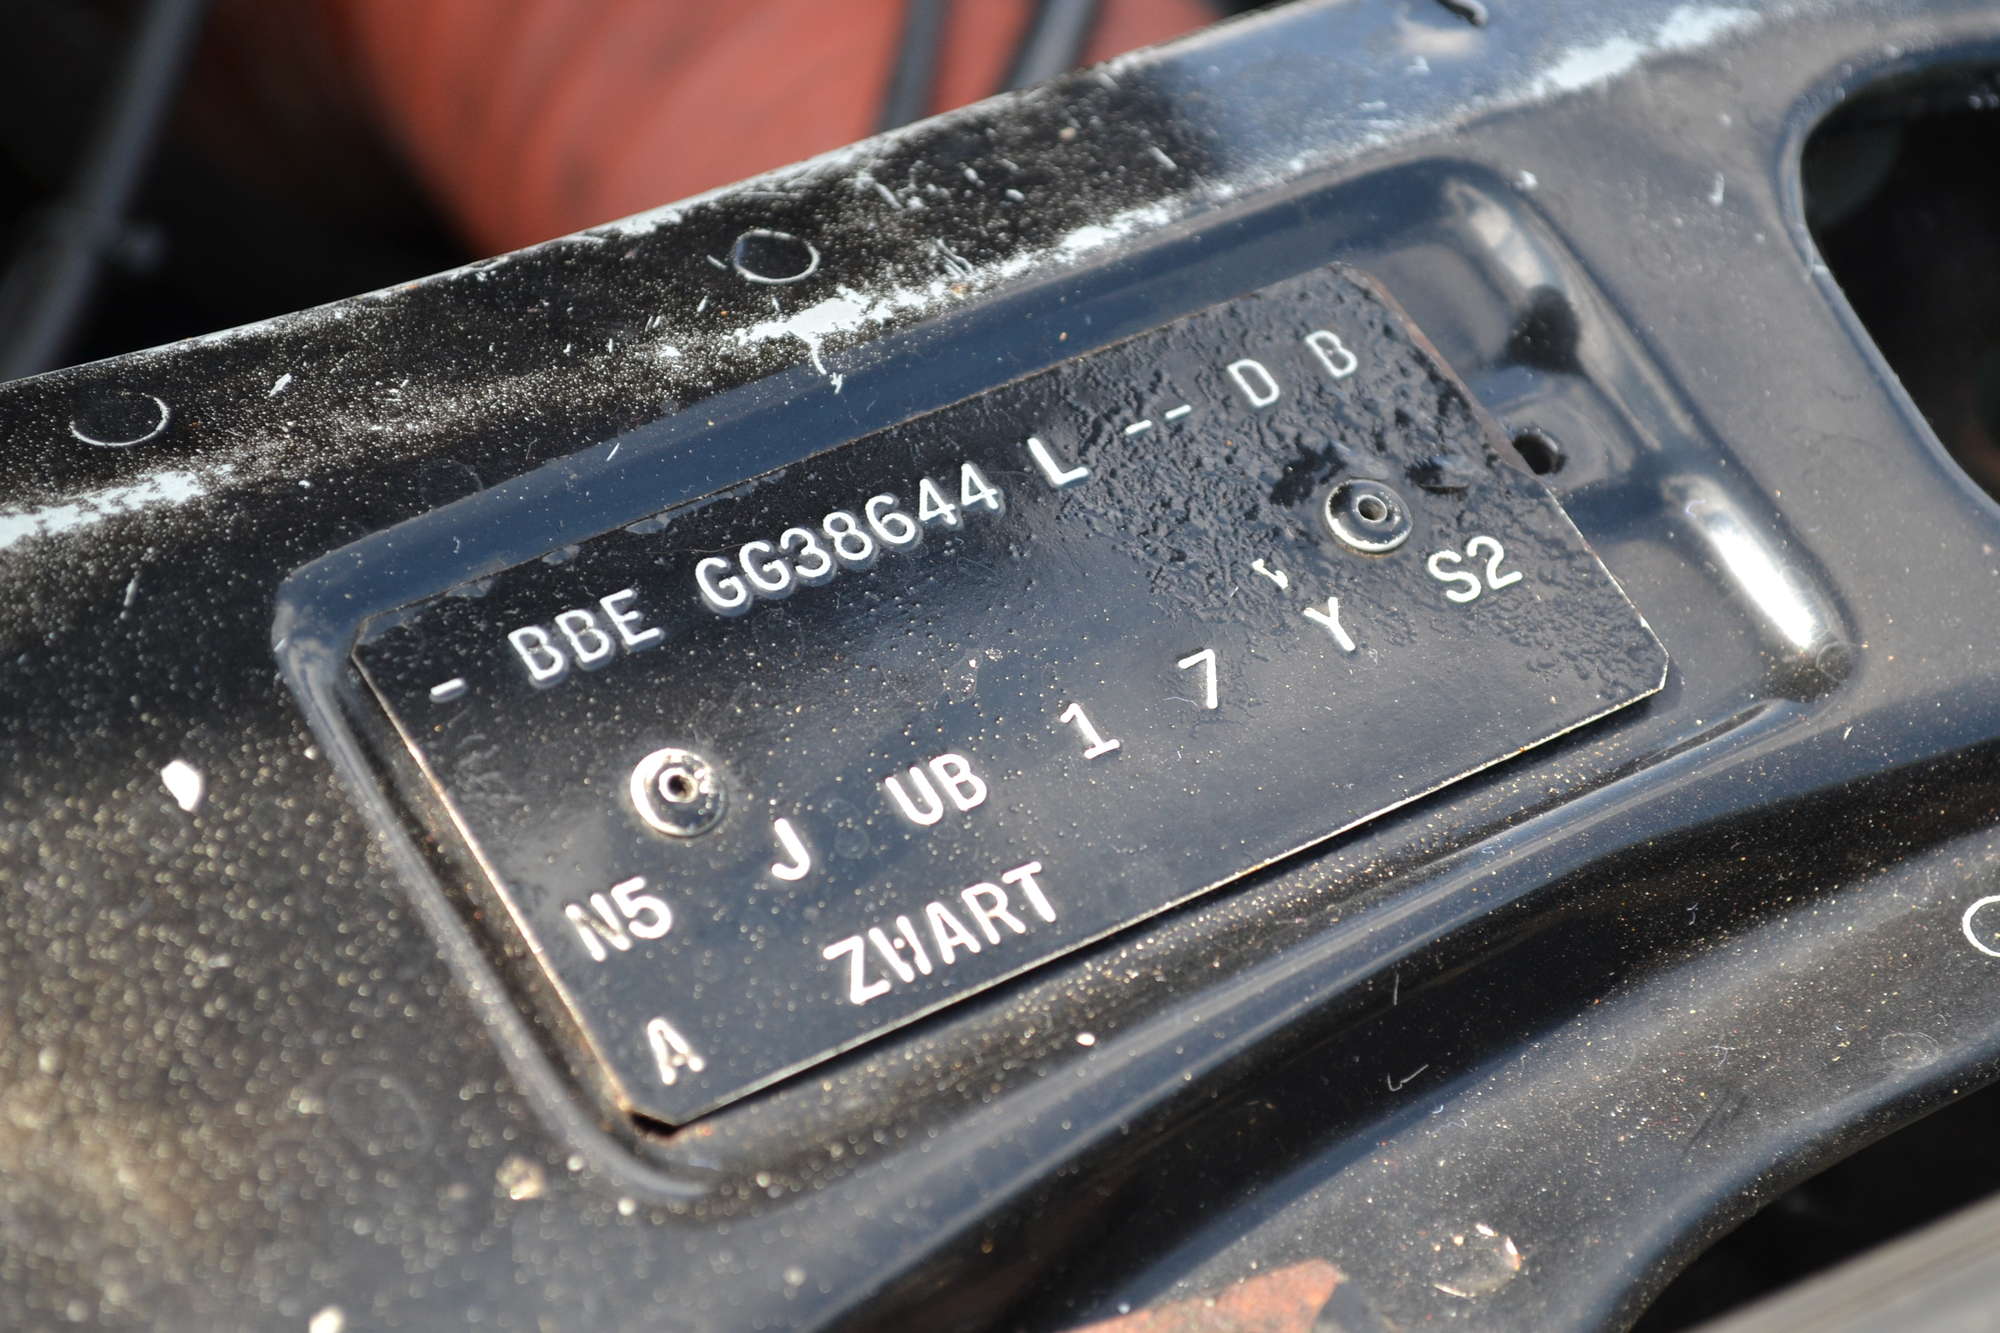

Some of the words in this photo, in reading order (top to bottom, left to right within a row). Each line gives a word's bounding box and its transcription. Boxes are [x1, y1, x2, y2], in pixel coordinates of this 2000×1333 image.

[428, 676, 468, 702] -
[507, 585, 664, 688] BBE
[694, 460, 1008, 614] GG38644
[1026, 434, 1088, 488] L
[1226, 356, 1281, 410] D
[1304, 328, 1359, 379] B
[563, 874, 674, 962] N5
[770, 816, 812, 882] J
[884, 752, 989, 827] UB
[1059, 702, 1121, 760] 1
[1177, 647, 1218, 710] 7
[1302, 596, 1356, 652] Y
[1427, 534, 1523, 604] S2
[645, 1016, 705, 1086] A
